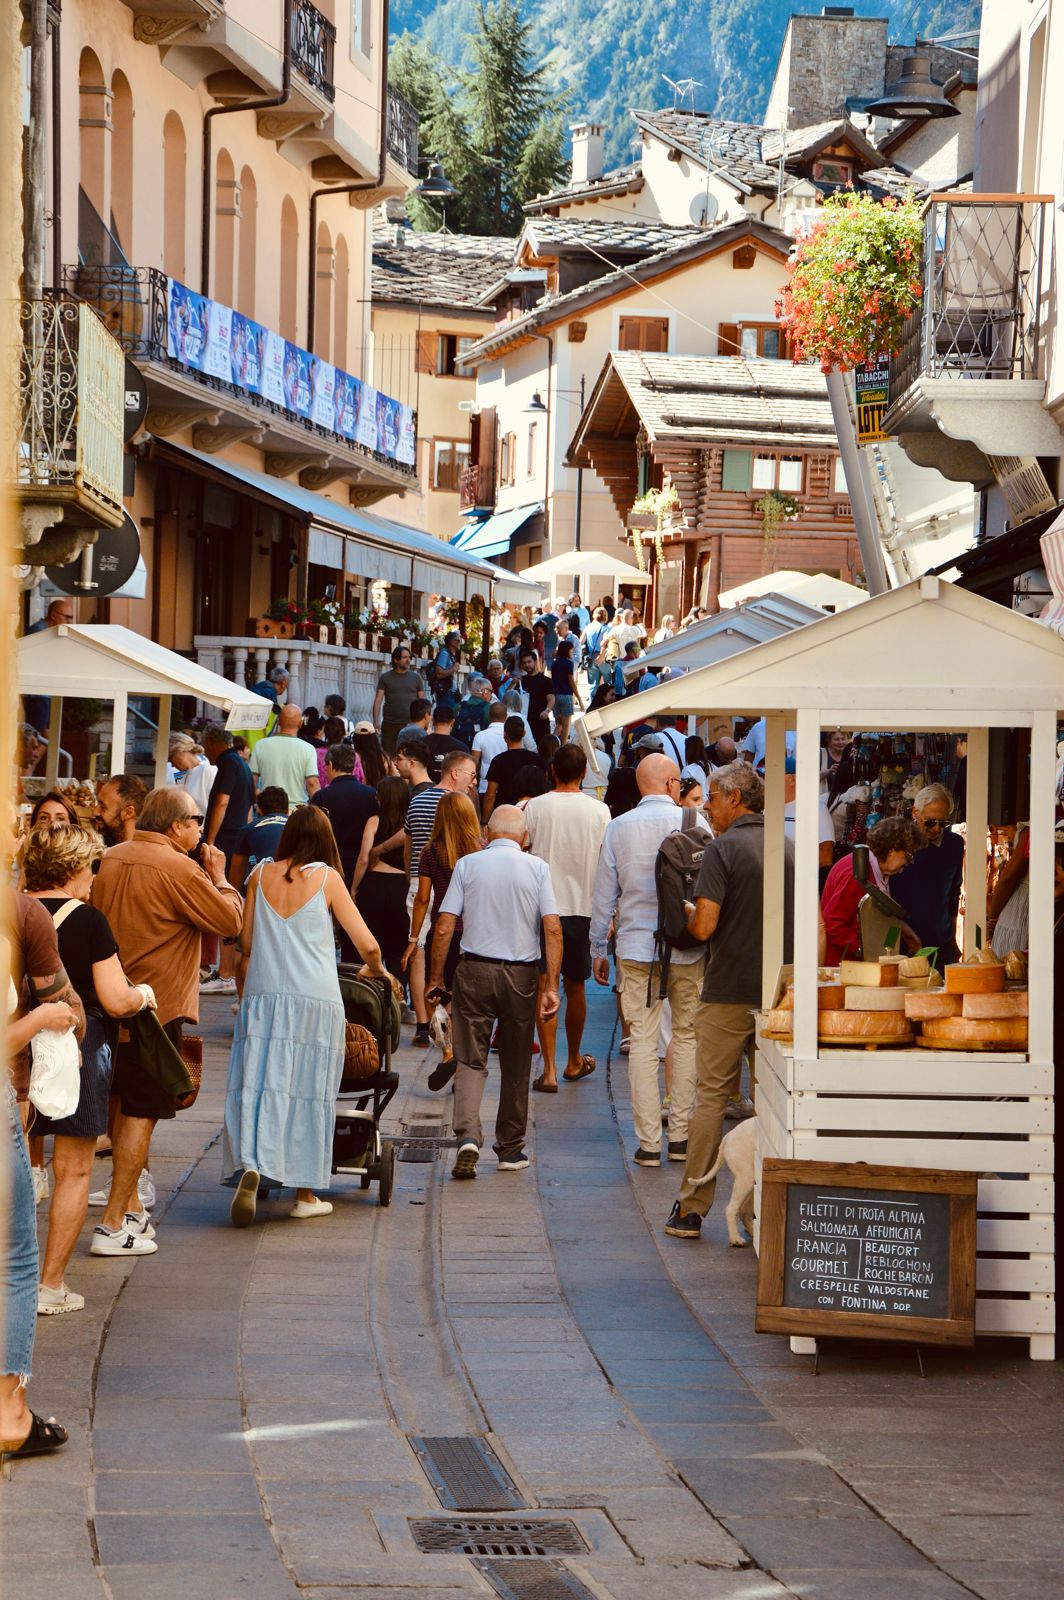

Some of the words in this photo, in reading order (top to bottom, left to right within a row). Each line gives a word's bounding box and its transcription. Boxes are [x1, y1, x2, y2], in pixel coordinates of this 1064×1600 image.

[856, 370, 889, 383] TABACCHI
[800, 1203, 838, 1217] FILETTI
[845, 1206, 855, 1219] DI
[858, 1207, 885, 1222] TROTA
[888, 1210, 925, 1225] ALPINA
[800, 1219, 859, 1236] SALMONATA
[866, 1224, 922, 1241] AFFUMICATA
[796, 1239, 847, 1256] FRANCIA
[865, 1241, 920, 1257] BEAUFORT
[791, 1257, 849, 1275] GOURMET
[865, 1255, 931, 1272] REBLOCHON
[800, 1279, 860, 1293] CRESPELLE
[867, 1284, 930, 1299] VALDOSTANE
[841, 1296, 887, 1311] FONTINA
[893, 1302, 911, 1312] D.O.P.
